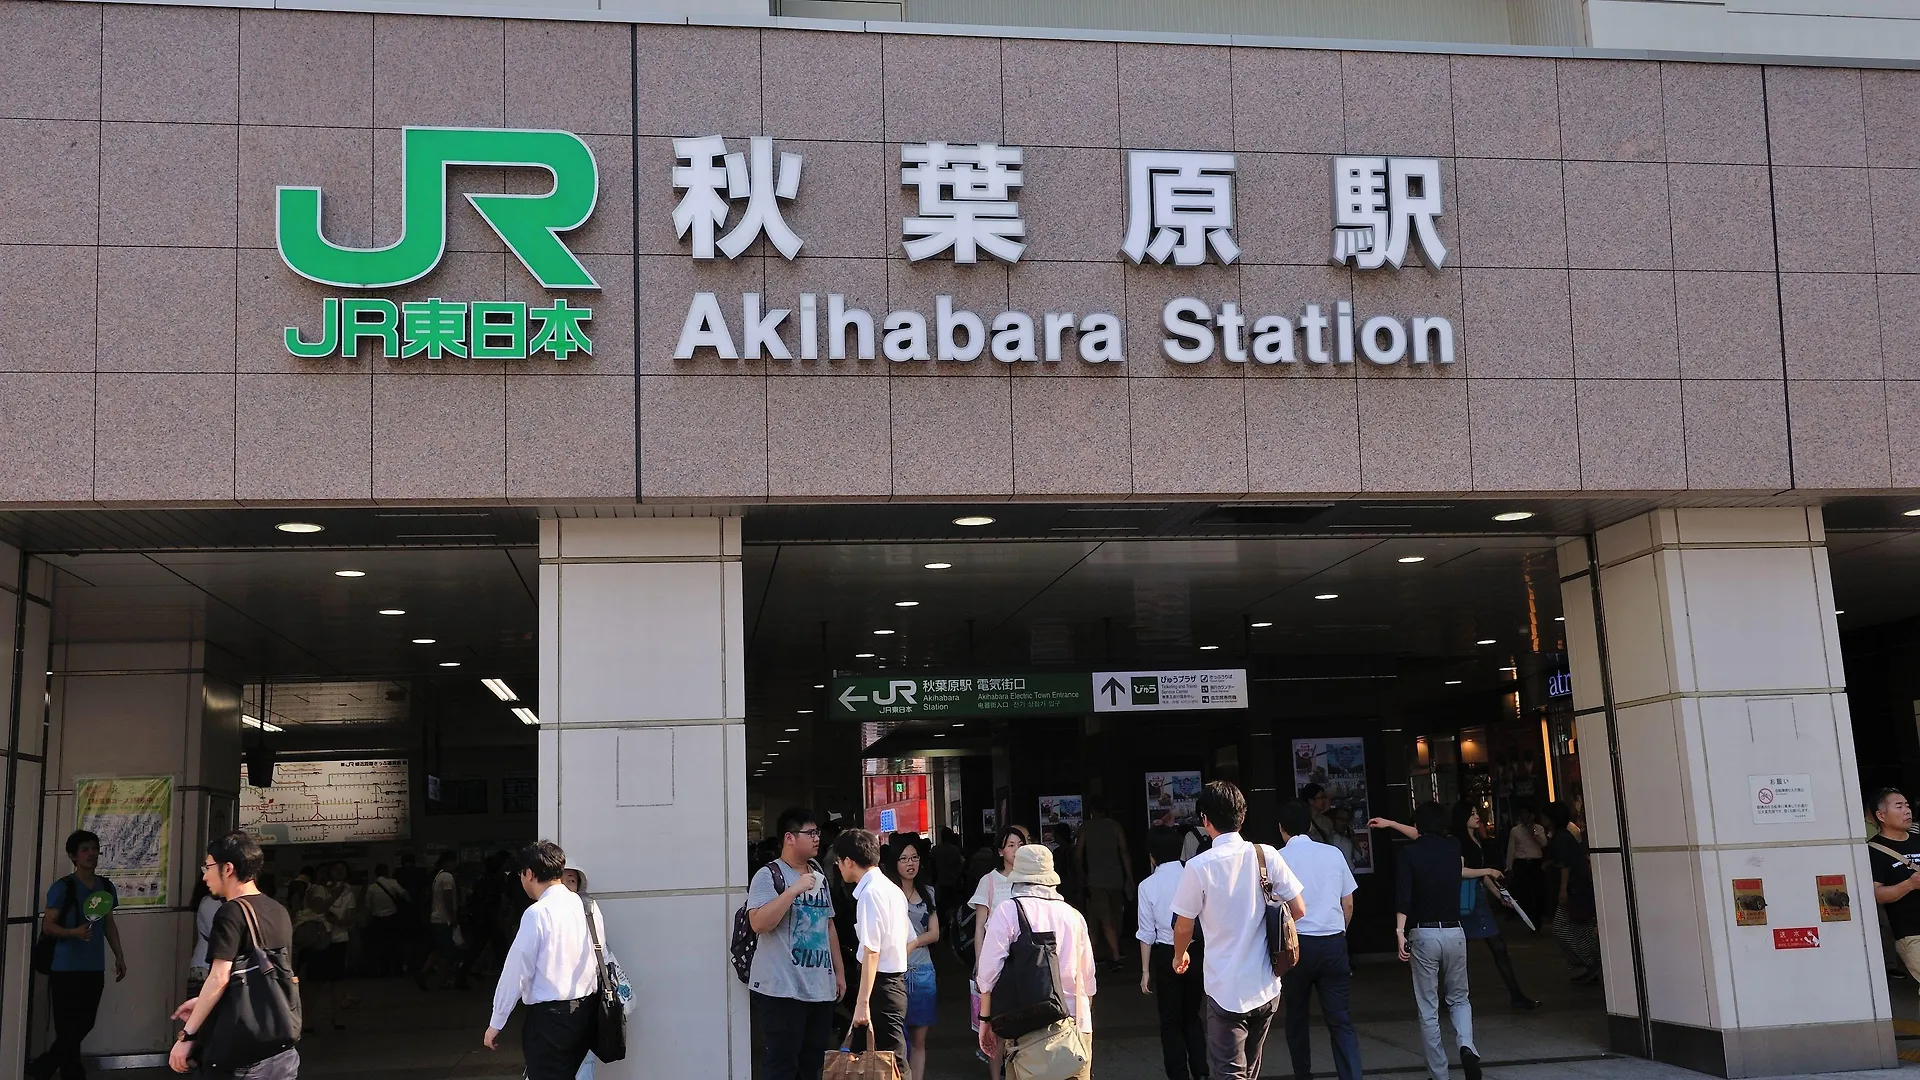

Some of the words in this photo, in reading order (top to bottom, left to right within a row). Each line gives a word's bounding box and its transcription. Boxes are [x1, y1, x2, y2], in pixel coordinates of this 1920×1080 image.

[276, 125, 602, 290] JR
[672, 134, 1449, 272] 秋葉原駅
[284, 298, 593, 361] JR東日本
[672, 292, 1125, 363] Akihabara
[1161, 297, 1455, 366] Station
[922, 679, 972, 692] 秋葉原駅
[977, 678, 1026, 691] 電気街口
[1160, 675, 1197, 683] びゅうプラザ
[872, 680, 918, 705] JR
[1133, 684, 1157, 694] びゅう
[923, 694, 960, 702] Akihabara
[978, 693, 1009, 701] Akihabara
[1010, 692, 1033, 700] Electric
[1034, 691, 1051, 699] Town
[1052, 691, 1079, 699] Entrance
[879, 706, 913, 714] JR東日本
[923, 703, 948, 711] Station
